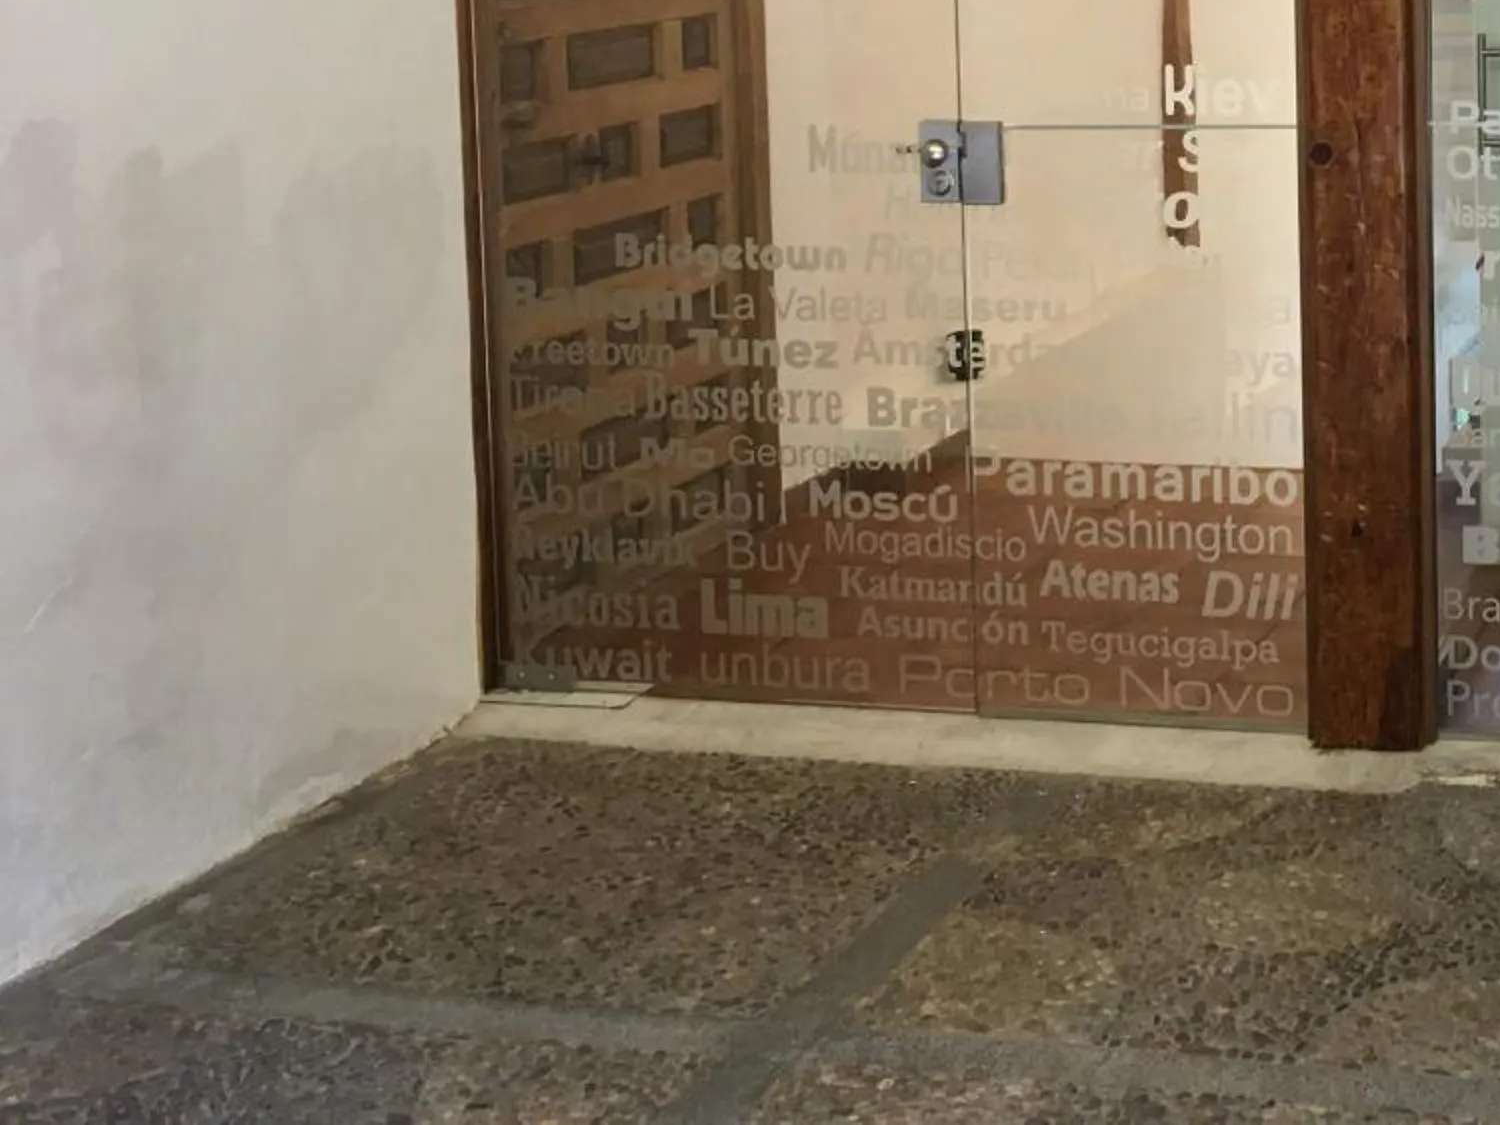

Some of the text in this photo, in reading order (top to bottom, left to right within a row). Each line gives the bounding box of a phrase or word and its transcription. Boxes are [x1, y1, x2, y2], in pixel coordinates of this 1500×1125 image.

[1164, 64, 1282, 117] Kiev
[615, 232, 847, 275] Bridgetown
[710, 286, 755, 321] La
[768, 285, 890, 326] Valeta
[904, 283, 1067, 324] Maseru
[512, 338, 675, 368] reetown
[688, 328, 839, 370] Túnez
[645, 373, 843, 426] Basseterre
[728, 433, 933, 476] Georgetown
[965, 449, 1299, 509] Paramaribo
[622, 478, 766, 523] Dhabi
[809, 480, 959, 523] Moscú
[726, 530, 812, 585] Buy
[824, 522, 1026, 563] Mogadiscio
[1027, 504, 1296, 563] Washington
[701, 578, 829, 640] Lima
[840, 566, 1028, 608] Katmandú
[1039, 560, 1181, 606] Atenas
[1201, 570, 1299, 621] Dili
[857, 606, 1281, 671] Asuncón Tegucigalpa
[899, 653, 1091, 706] Porto
[1119, 667, 1296, 718] Novo
